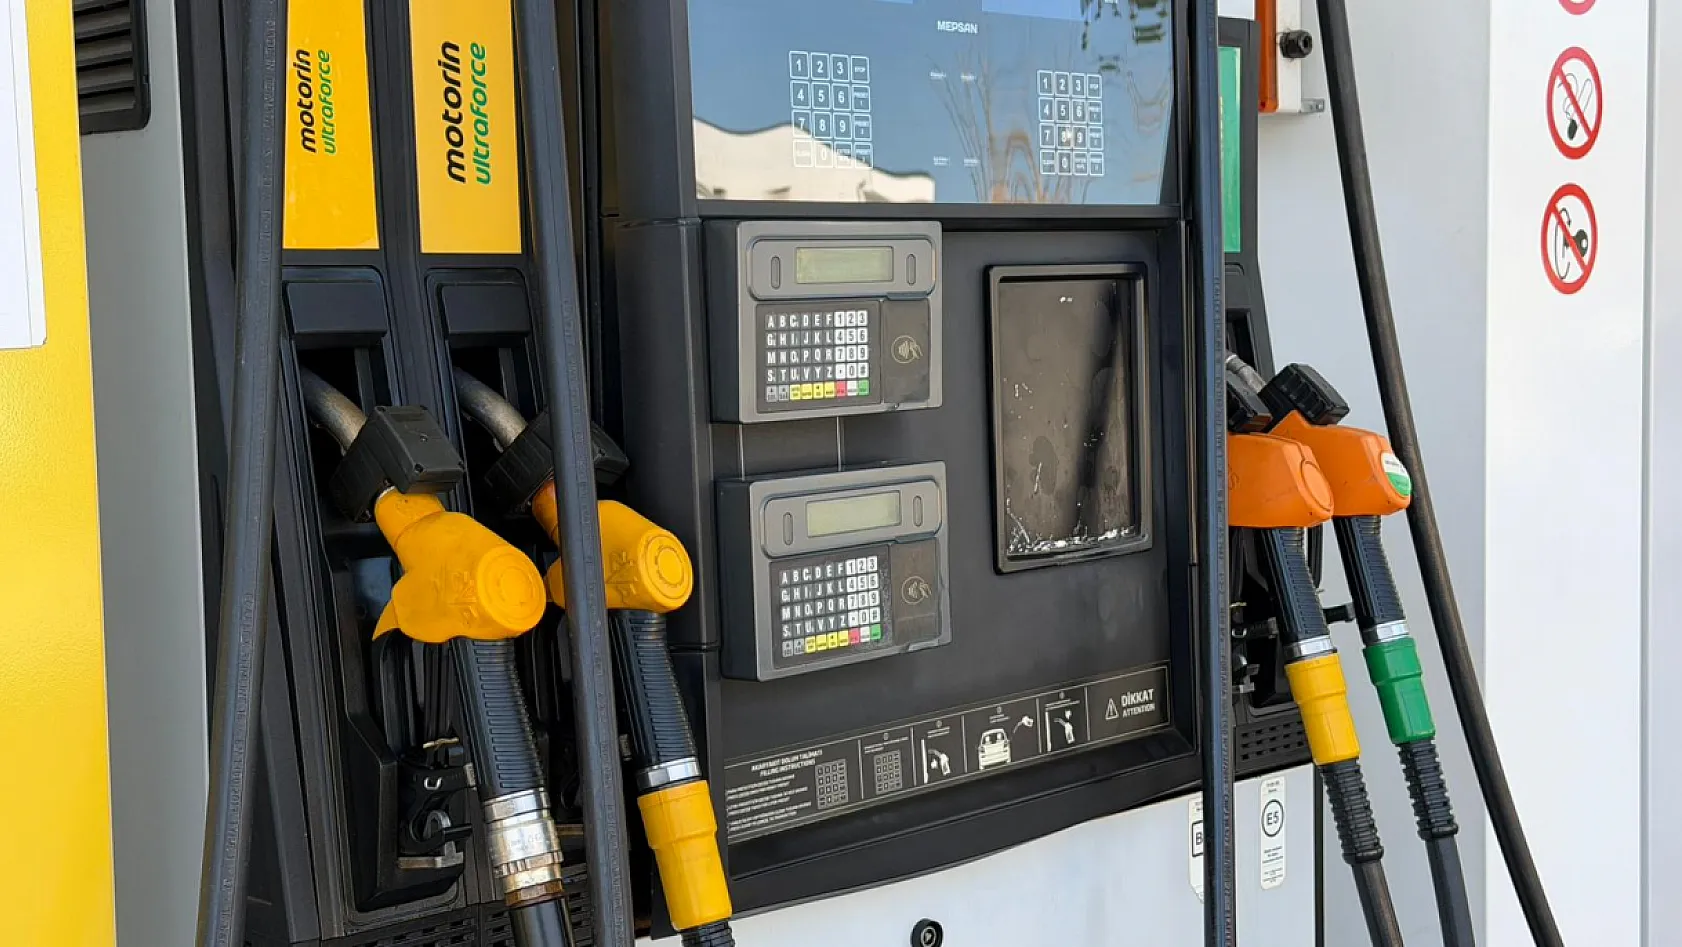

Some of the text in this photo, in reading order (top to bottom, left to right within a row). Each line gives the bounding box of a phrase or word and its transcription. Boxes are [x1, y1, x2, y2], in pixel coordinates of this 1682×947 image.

[937, 20, 978, 34] MEPSAN
[292, 49, 316, 153] motorin
[318, 50, 336, 155] ultraforce
[437, 40, 466, 184] motorin
[470, 42, 491, 185] ultraforce
[1121, 688, 1154, 707] DİKKAT
[1123, 702, 1155, 718] ATTENTION
[1267, 812, 1279, 826] E5
